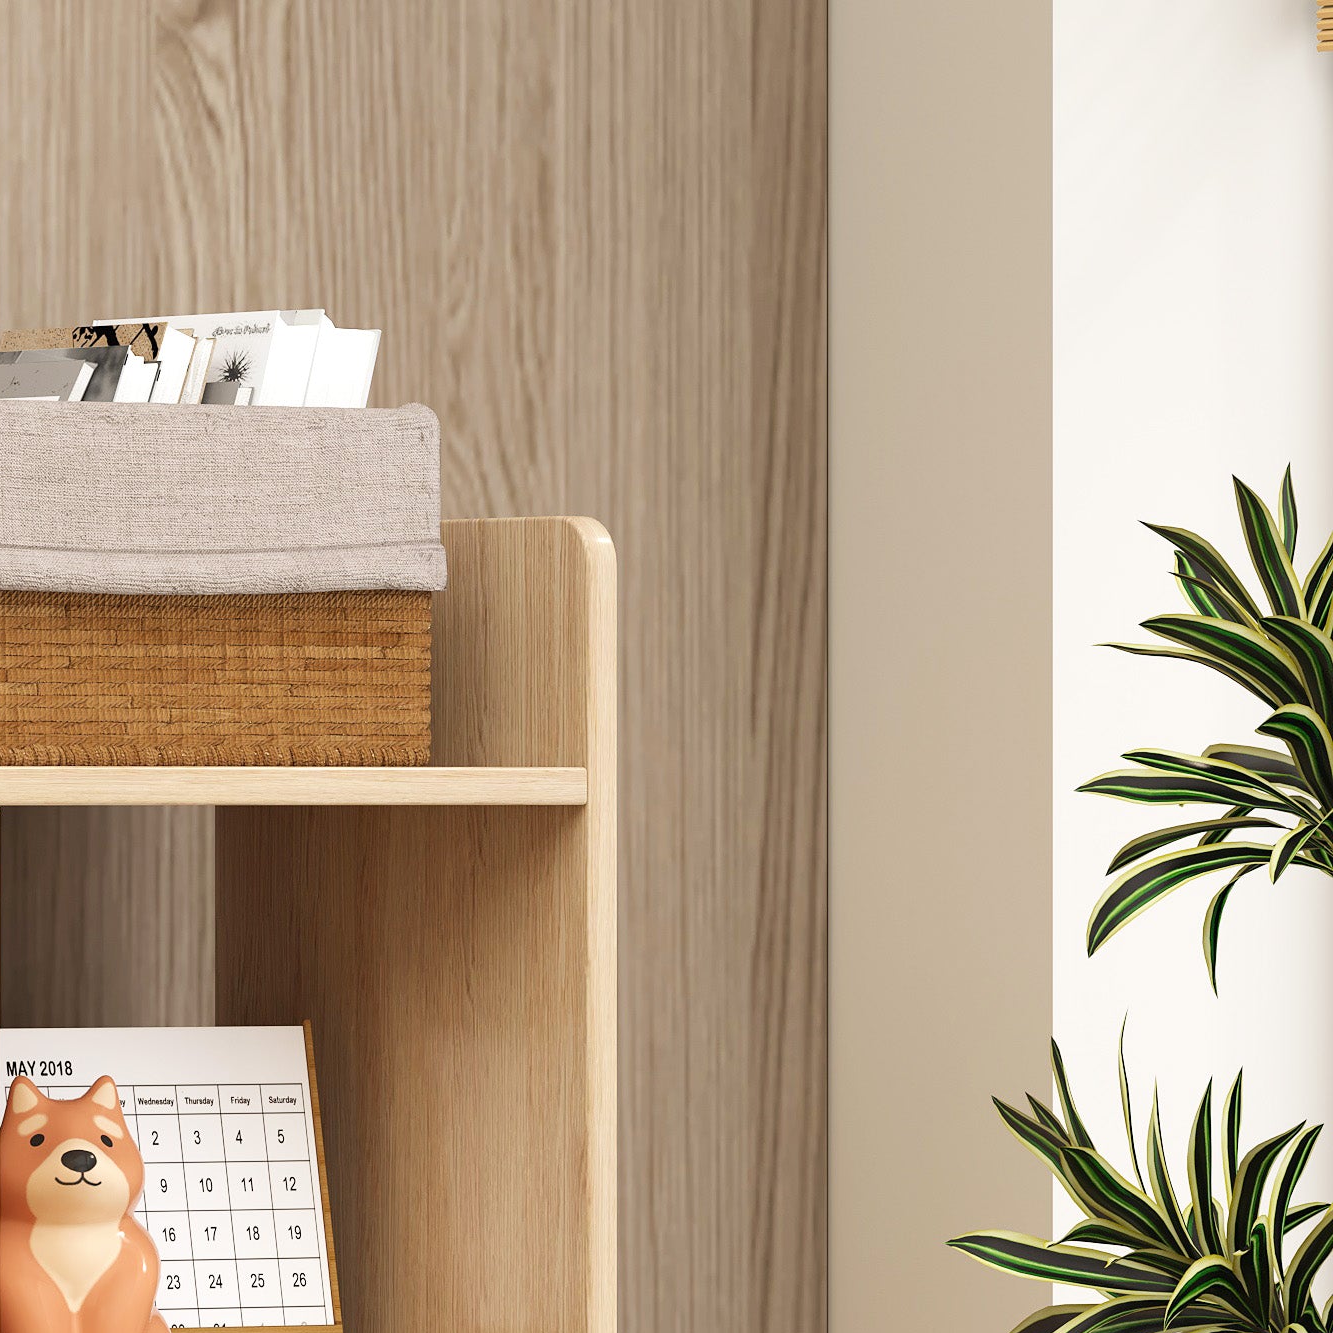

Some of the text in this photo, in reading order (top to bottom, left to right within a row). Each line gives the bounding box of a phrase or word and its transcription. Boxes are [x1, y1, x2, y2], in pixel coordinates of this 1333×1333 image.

[6, 1060, 73, 1077] MAY 2018
[137, 1096, 297, 1107] Wednesday Thursday Friday Saturday
[151, 1129, 285, 1146] 2 3 4 5
[160, 1177, 297, 1193] 9 10 11 12
[162, 1225, 302, 1242] 16 17 18 19
[166, 1272, 307, 1290] 23 24 25 26
